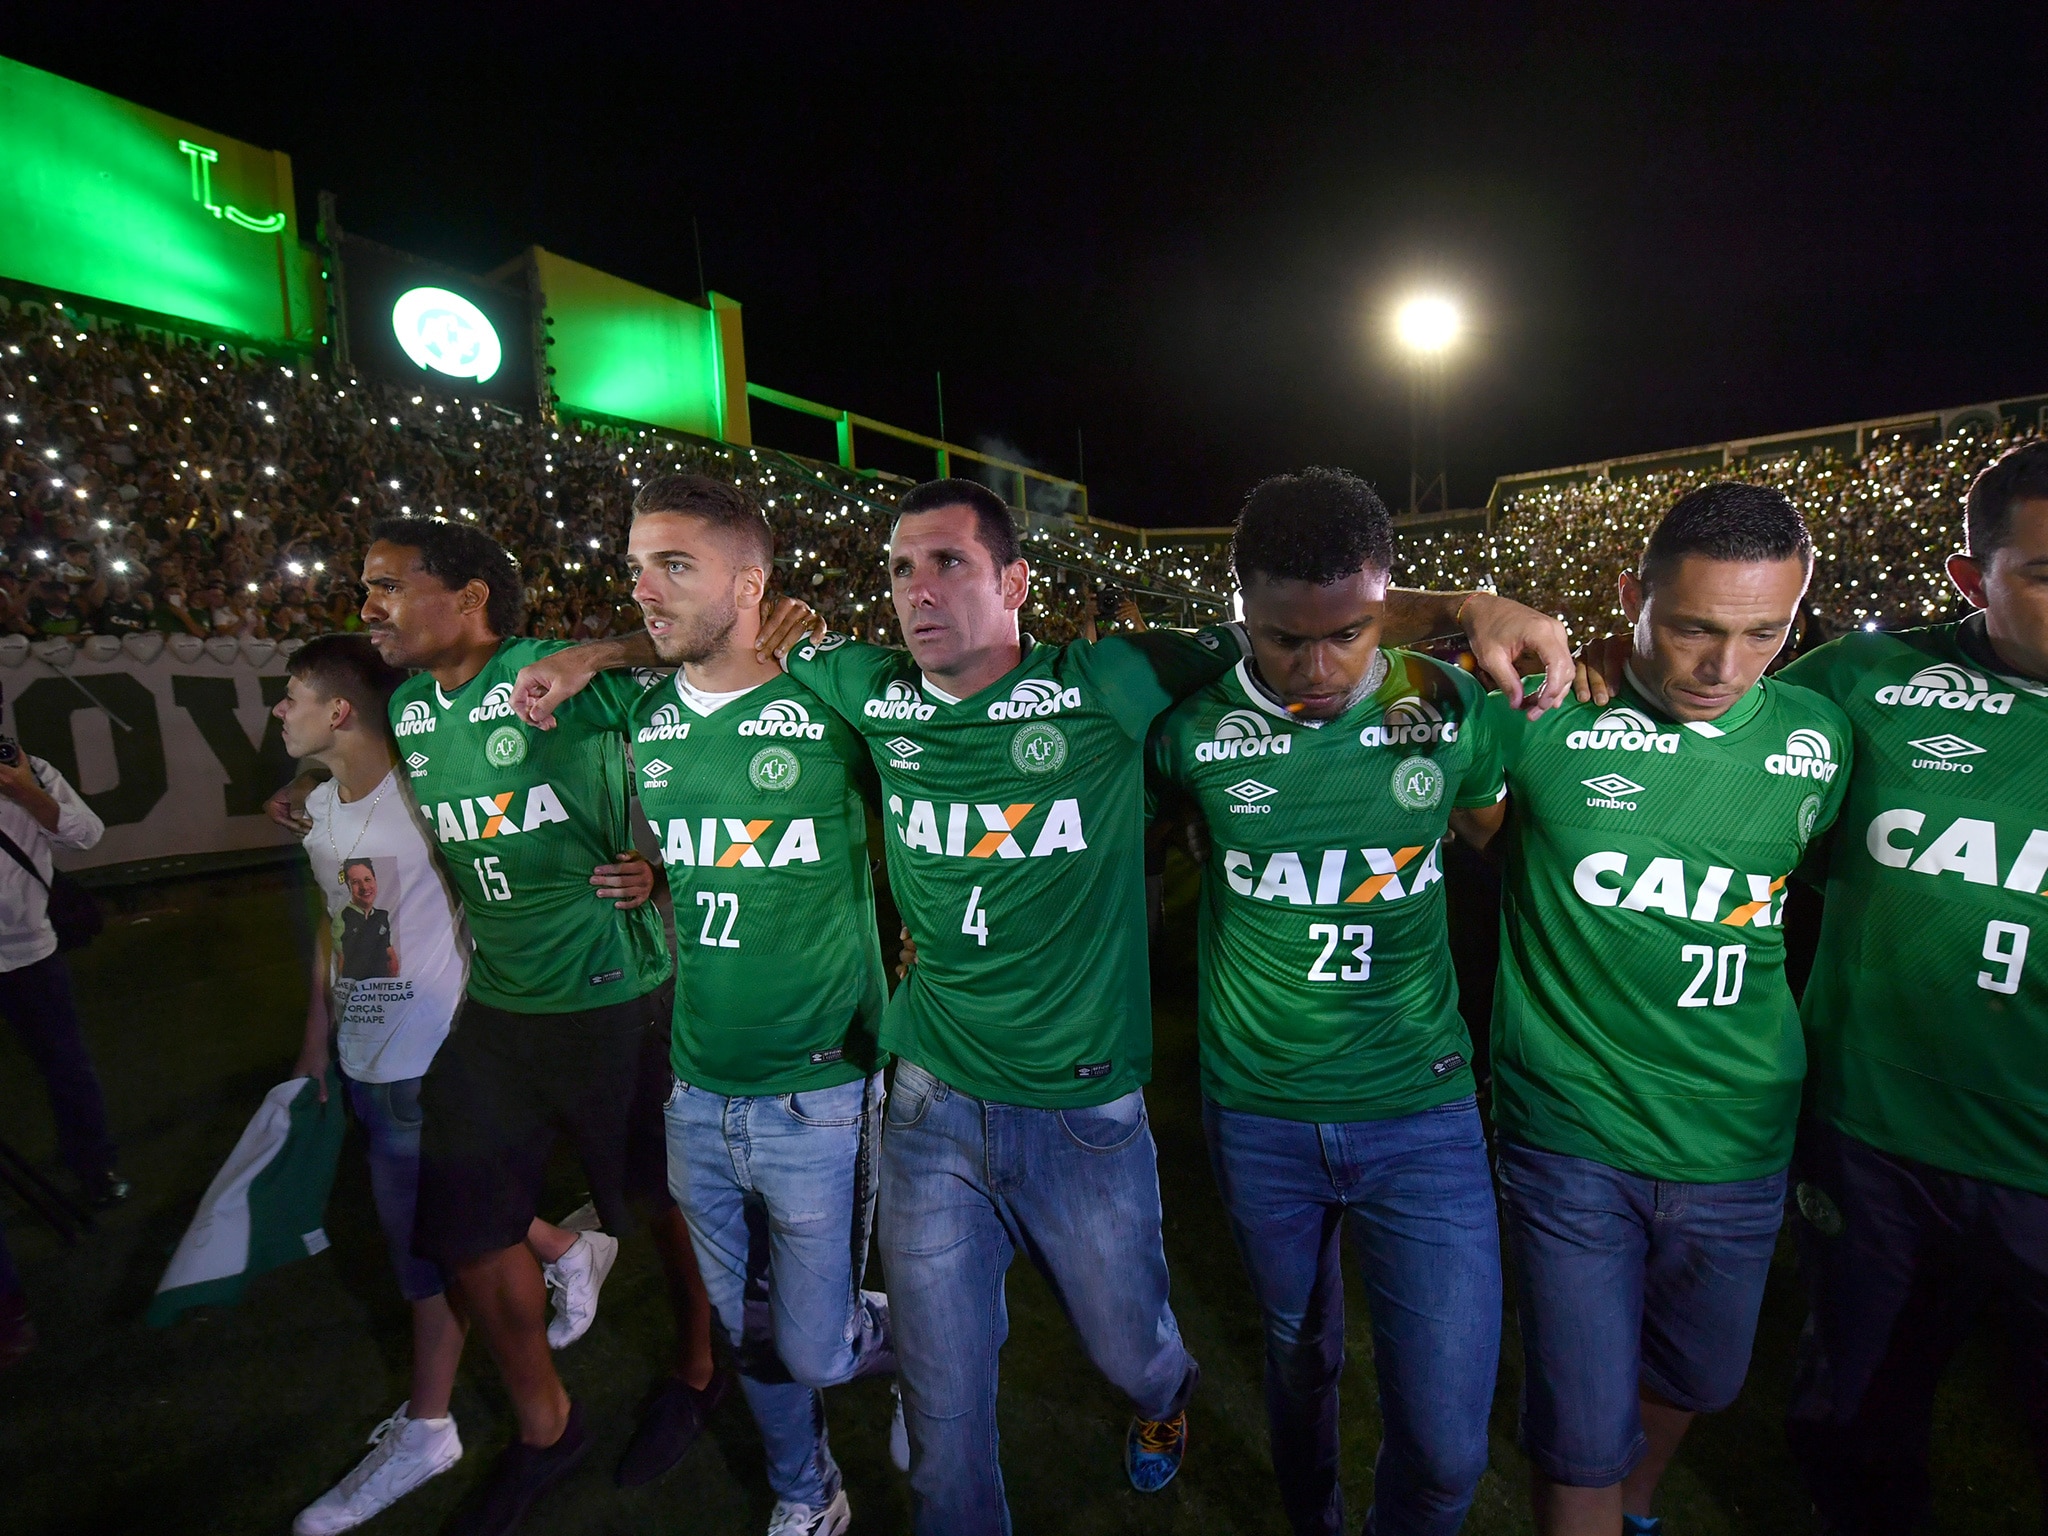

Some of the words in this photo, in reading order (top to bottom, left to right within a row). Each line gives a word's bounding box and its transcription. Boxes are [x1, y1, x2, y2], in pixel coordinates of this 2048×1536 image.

[863, 699, 937, 721] aurora
[987, 686, 1082, 721] aurora
[1875, 685, 2016, 715] aurora
[468, 702, 516, 724] auro
[637, 722, 691, 743] aurora
[738, 719, 825, 742] aurora
[1359, 722, 1459, 747] aurora
[1565, 729, 1681, 755] aurora
[495, 737, 516, 758] ACF
[1025, 736, 1054, 763] ACF
[1195, 734, 1292, 762] aurora
[410, 767, 428, 778] umbro
[760, 758, 788, 780] ACF
[889, 757, 921, 771] umbro
[1912, 758, 1974, 774] umbro
[643, 777, 668, 789] umbro
[1405, 770, 1435, 796] ACF
[1229, 803, 1272, 815] umbro
[1586, 797, 1637, 812] umbro
[1866, 808, 2048, 897] CAI
[473, 856, 512, 902] 15
[1224, 838, 1443, 905] CAIXA
[1573, 851, 1794, 928] CAIX
[696, 891, 740, 948] 22
[961, 886, 989, 947] 4
[1307, 923, 1374, 982] 23
[1976, 919, 2031, 995] 9
[361, 982, 403, 991] LIMITES
[405, 980, 413, 989] E
[1677, 944, 1747, 1008] 20
[351, 993, 376, 1002] COM
[378, 991, 414, 1002] TODAS
